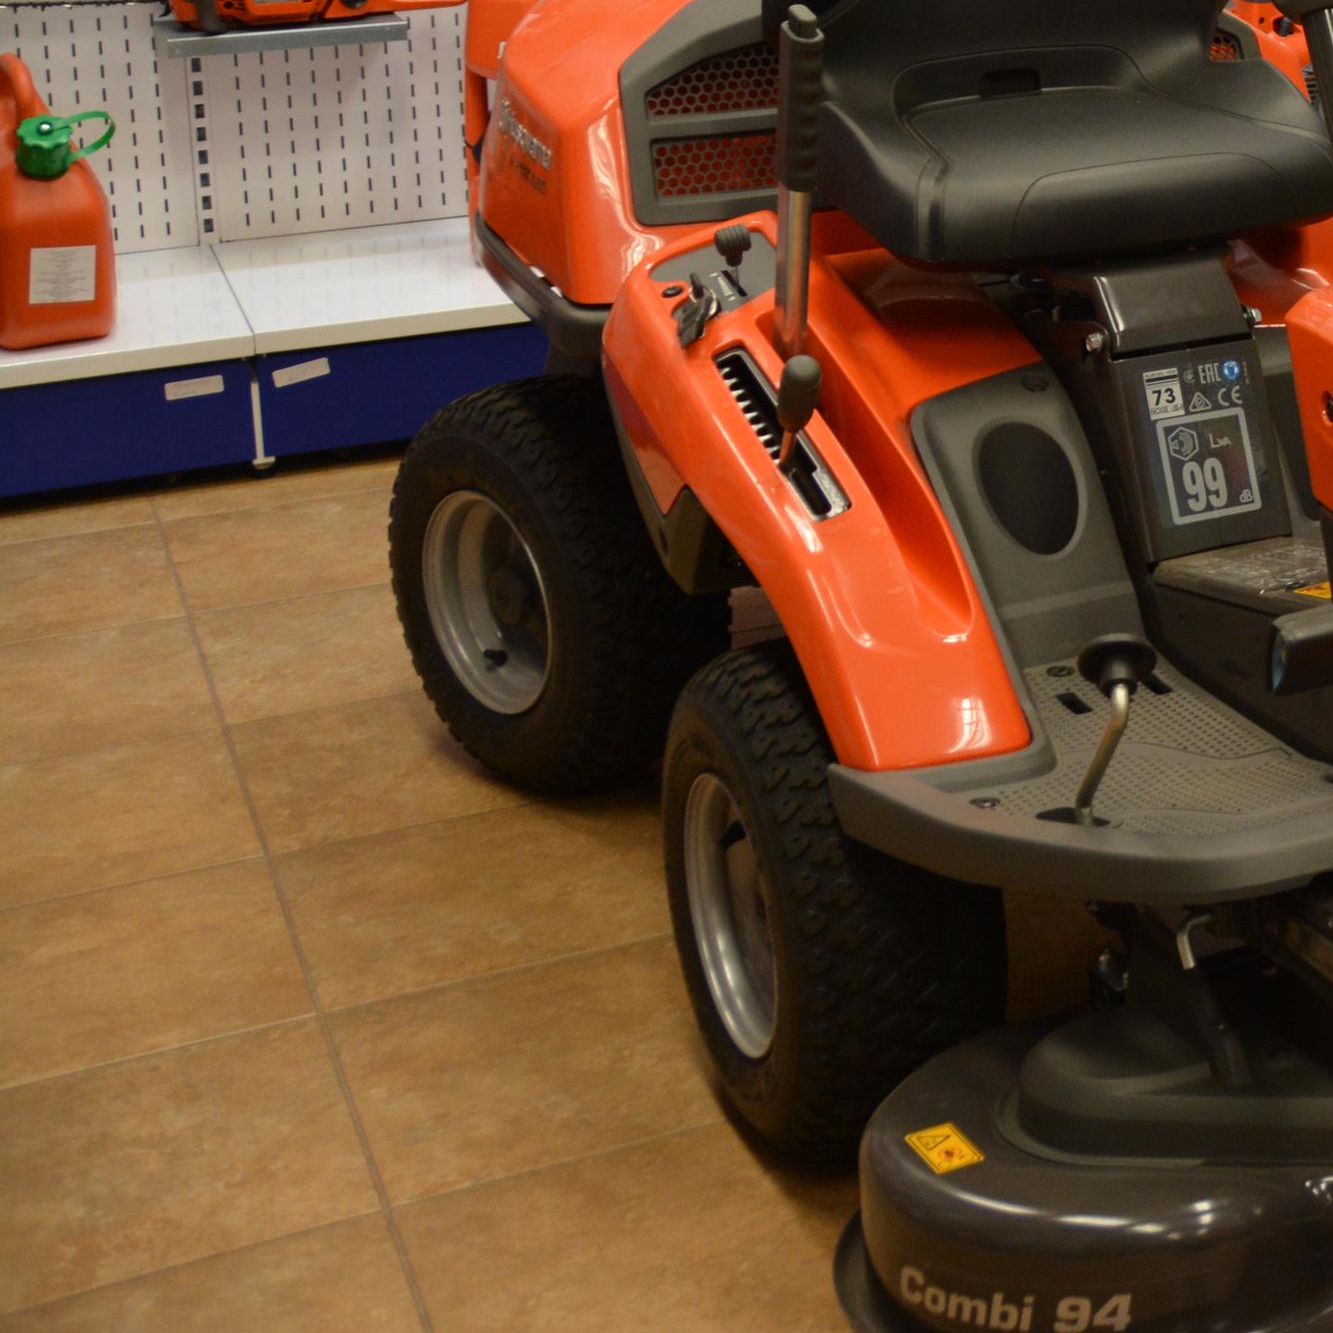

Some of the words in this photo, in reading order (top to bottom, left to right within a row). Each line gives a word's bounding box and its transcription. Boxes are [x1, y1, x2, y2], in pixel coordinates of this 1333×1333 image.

[1152, 387, 1176, 407] 73
[1181, 457, 1228, 512] 99
[900, 1265, 1036, 1333] Combi
[1052, 1293, 1133, 1333] 94
